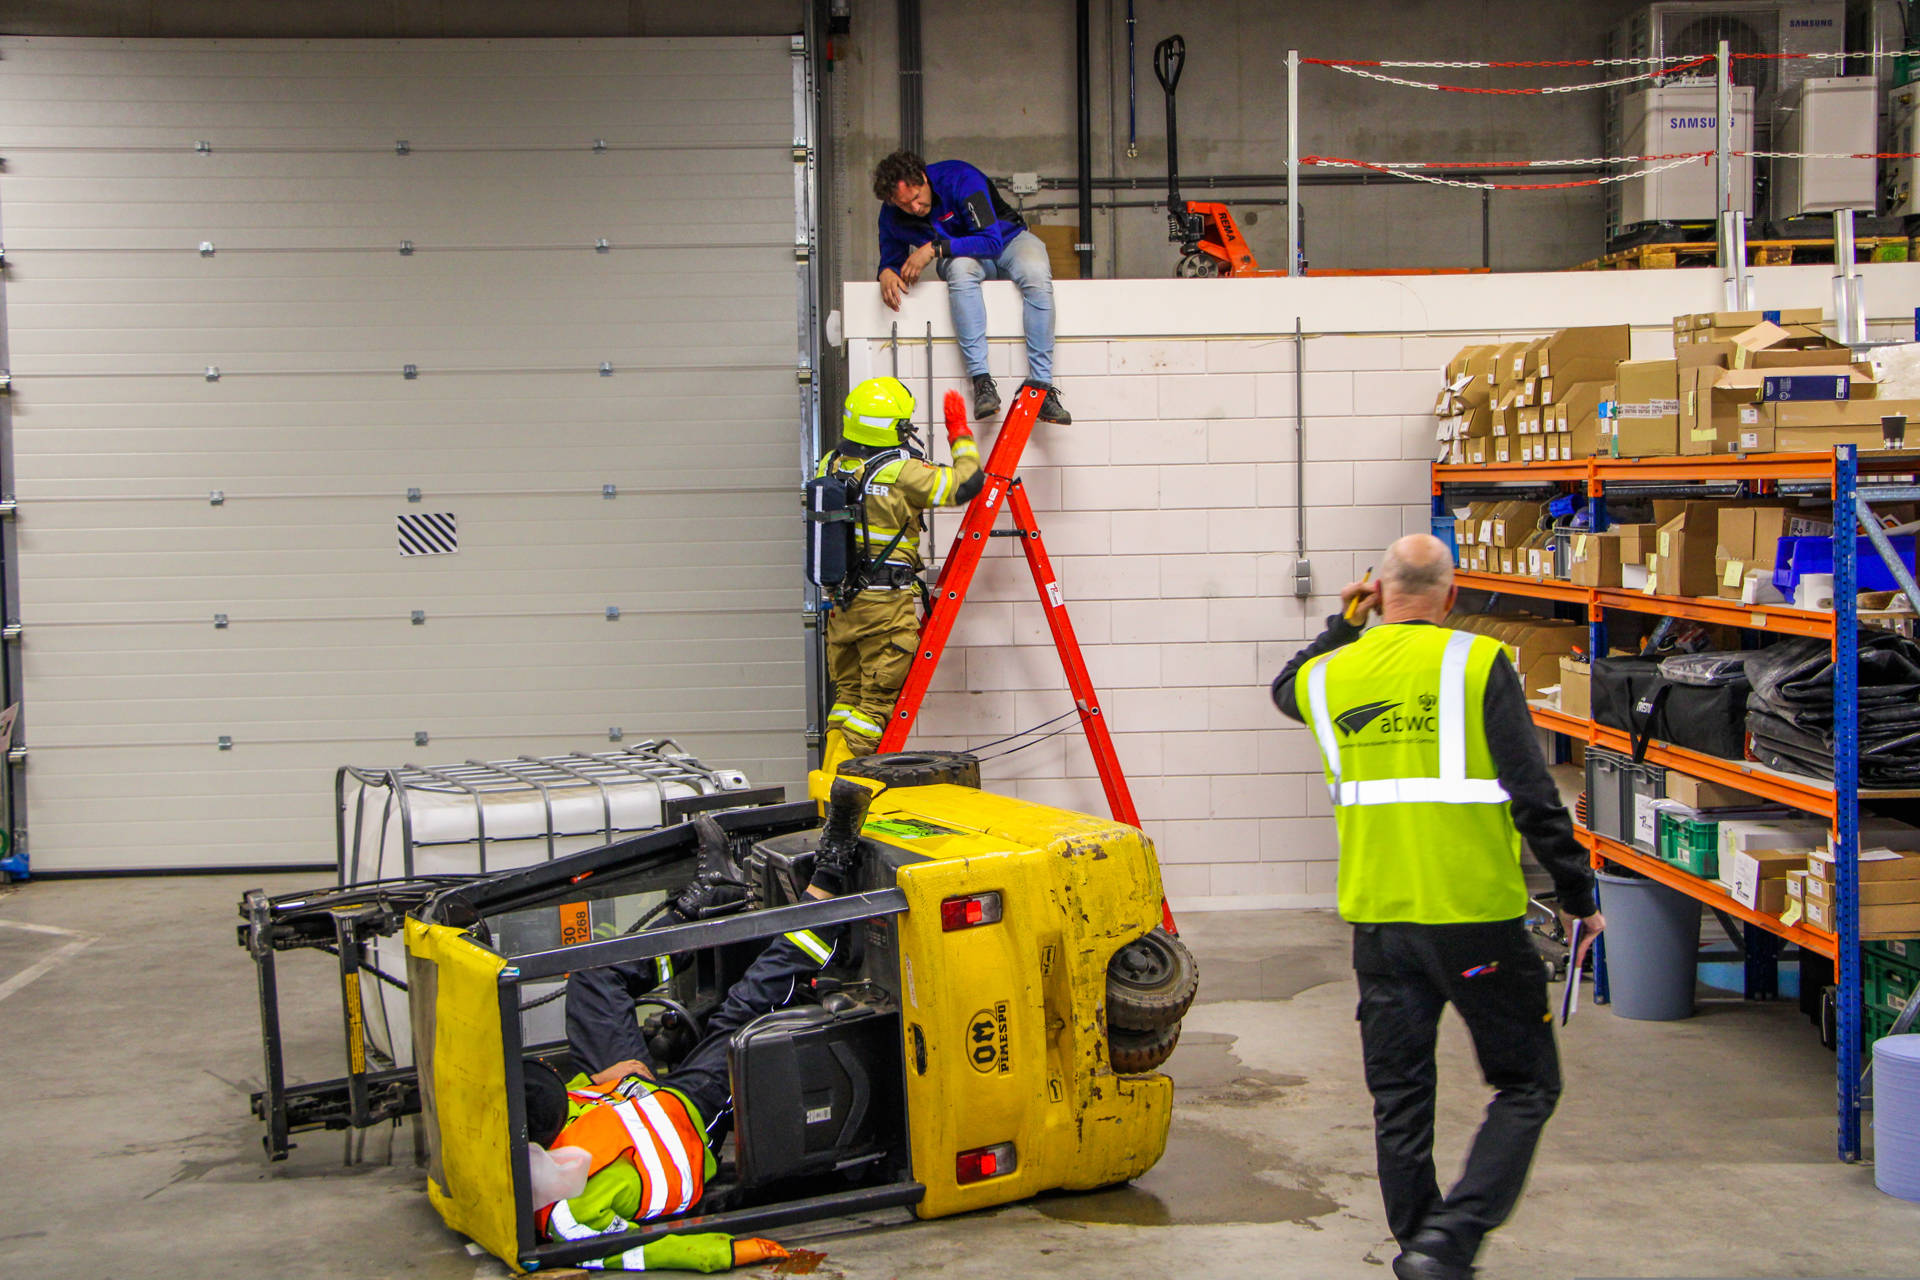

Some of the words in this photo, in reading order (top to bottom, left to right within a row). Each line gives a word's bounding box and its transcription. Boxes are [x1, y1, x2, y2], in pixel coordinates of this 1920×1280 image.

[1790, 19, 1832, 27] SAMSUNG
[1670, 117, 1735, 129] SAMSU
[1218, 212, 1236, 242] REMA
[1380, 710, 1436, 734] abwc
[563, 927, 577, 945] 30
[576, 911, 588, 940] 1268
[972, 1020, 997, 1064] OM
[997, 1004, 1010, 1073] PIMESPO
